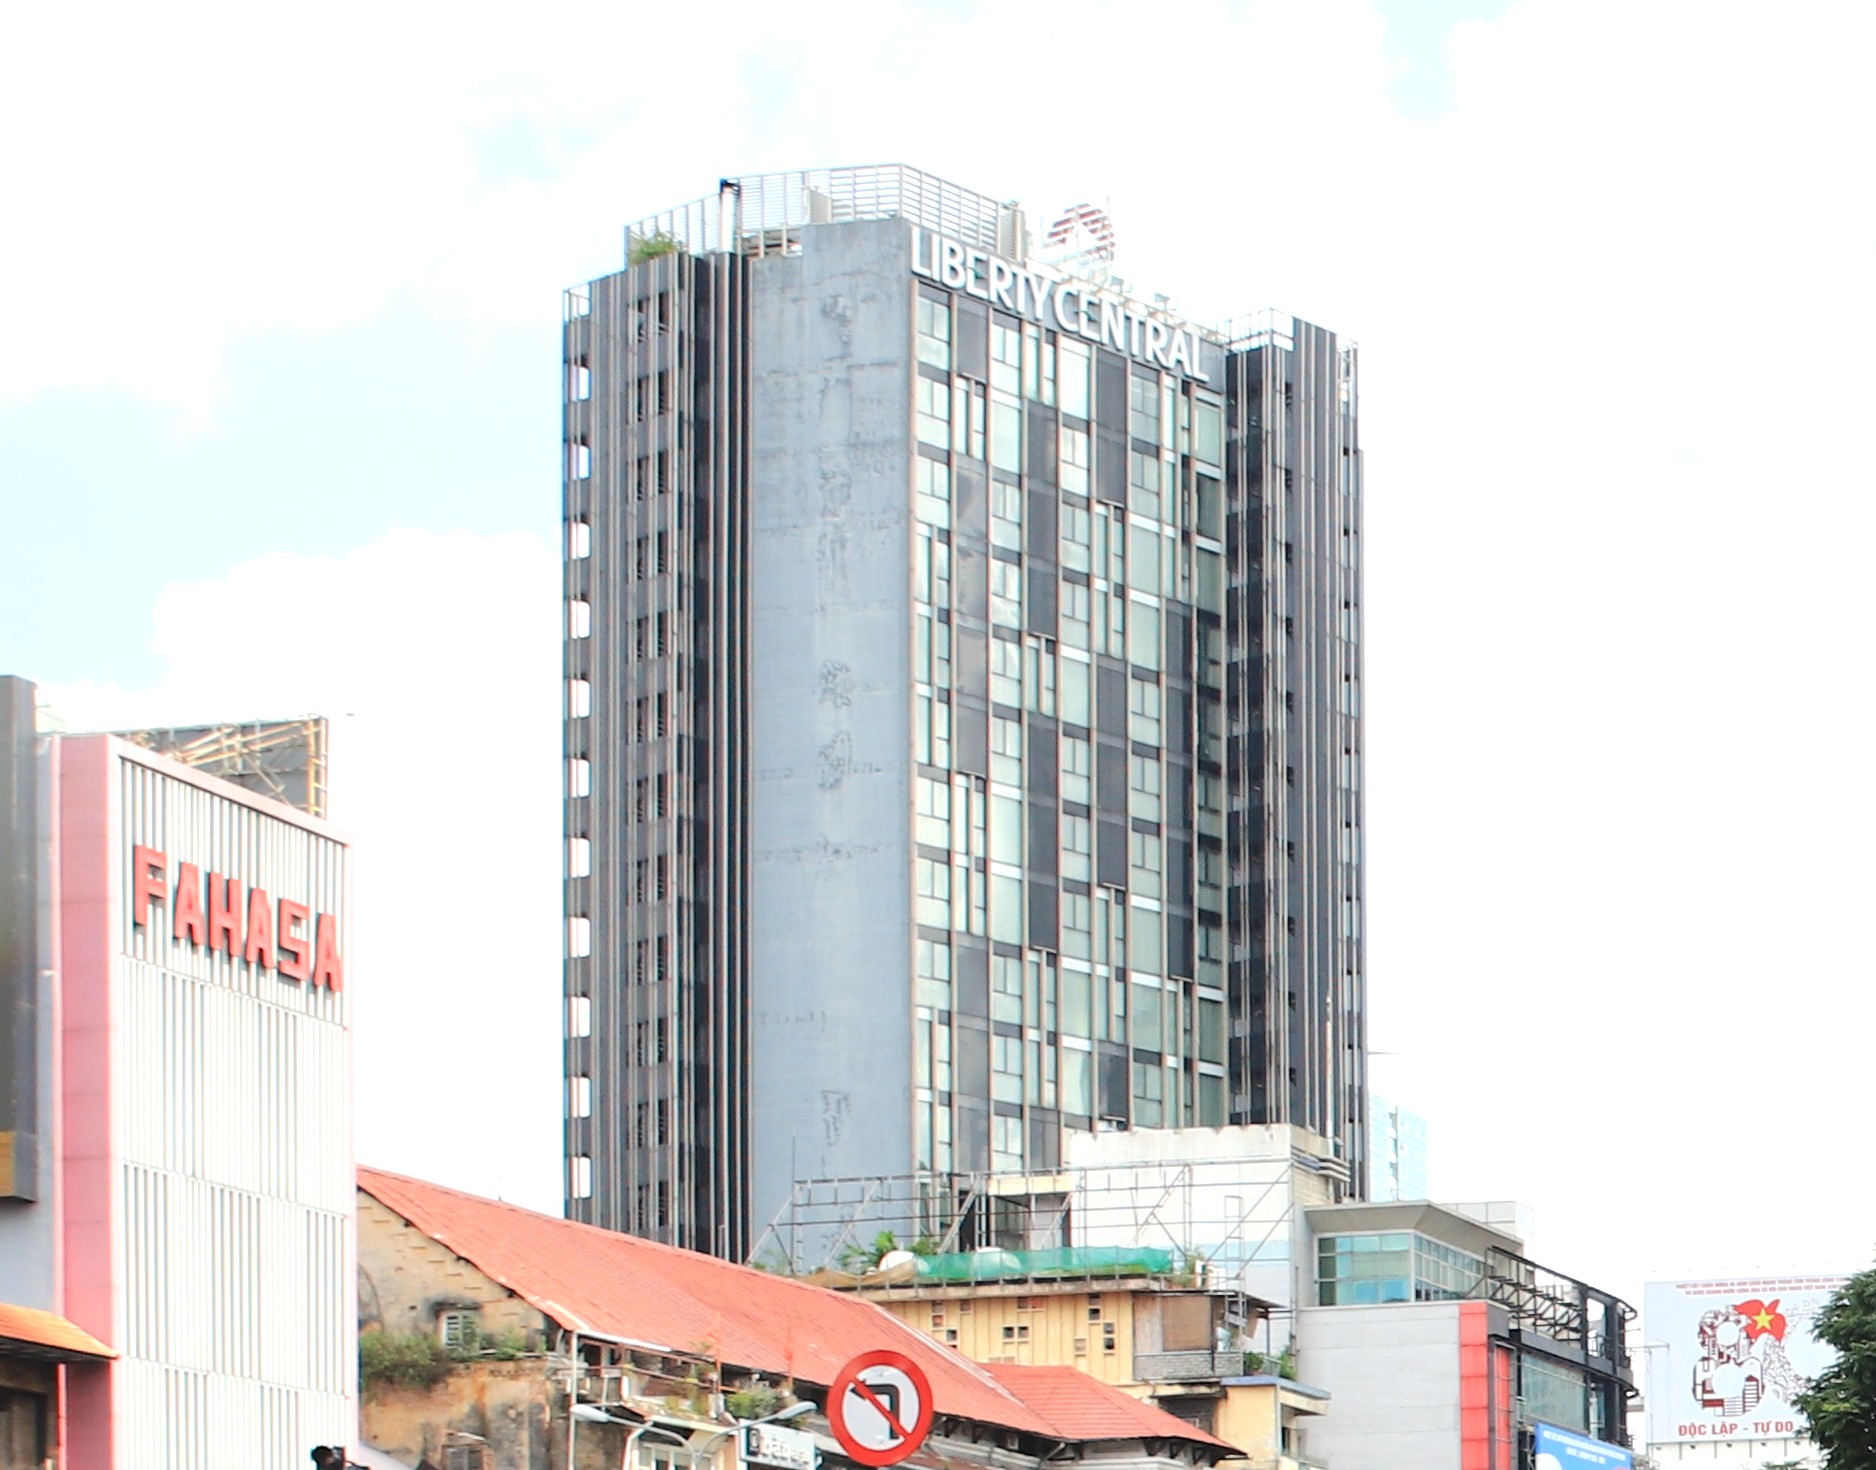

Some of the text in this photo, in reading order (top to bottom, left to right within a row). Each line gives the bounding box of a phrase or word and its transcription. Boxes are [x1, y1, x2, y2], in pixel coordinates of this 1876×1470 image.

[911, 225, 1210, 383] LIBERTY CENTRAL
[134, 844, 343, 993] FAHASA
[1678, 1422, 1707, 1438] ĐỘC
[1712, 1421, 1738, 1437] LẬP
[1753, 1420, 1772, 1436] TỰ
[1775, 1421, 1794, 1432] DO
